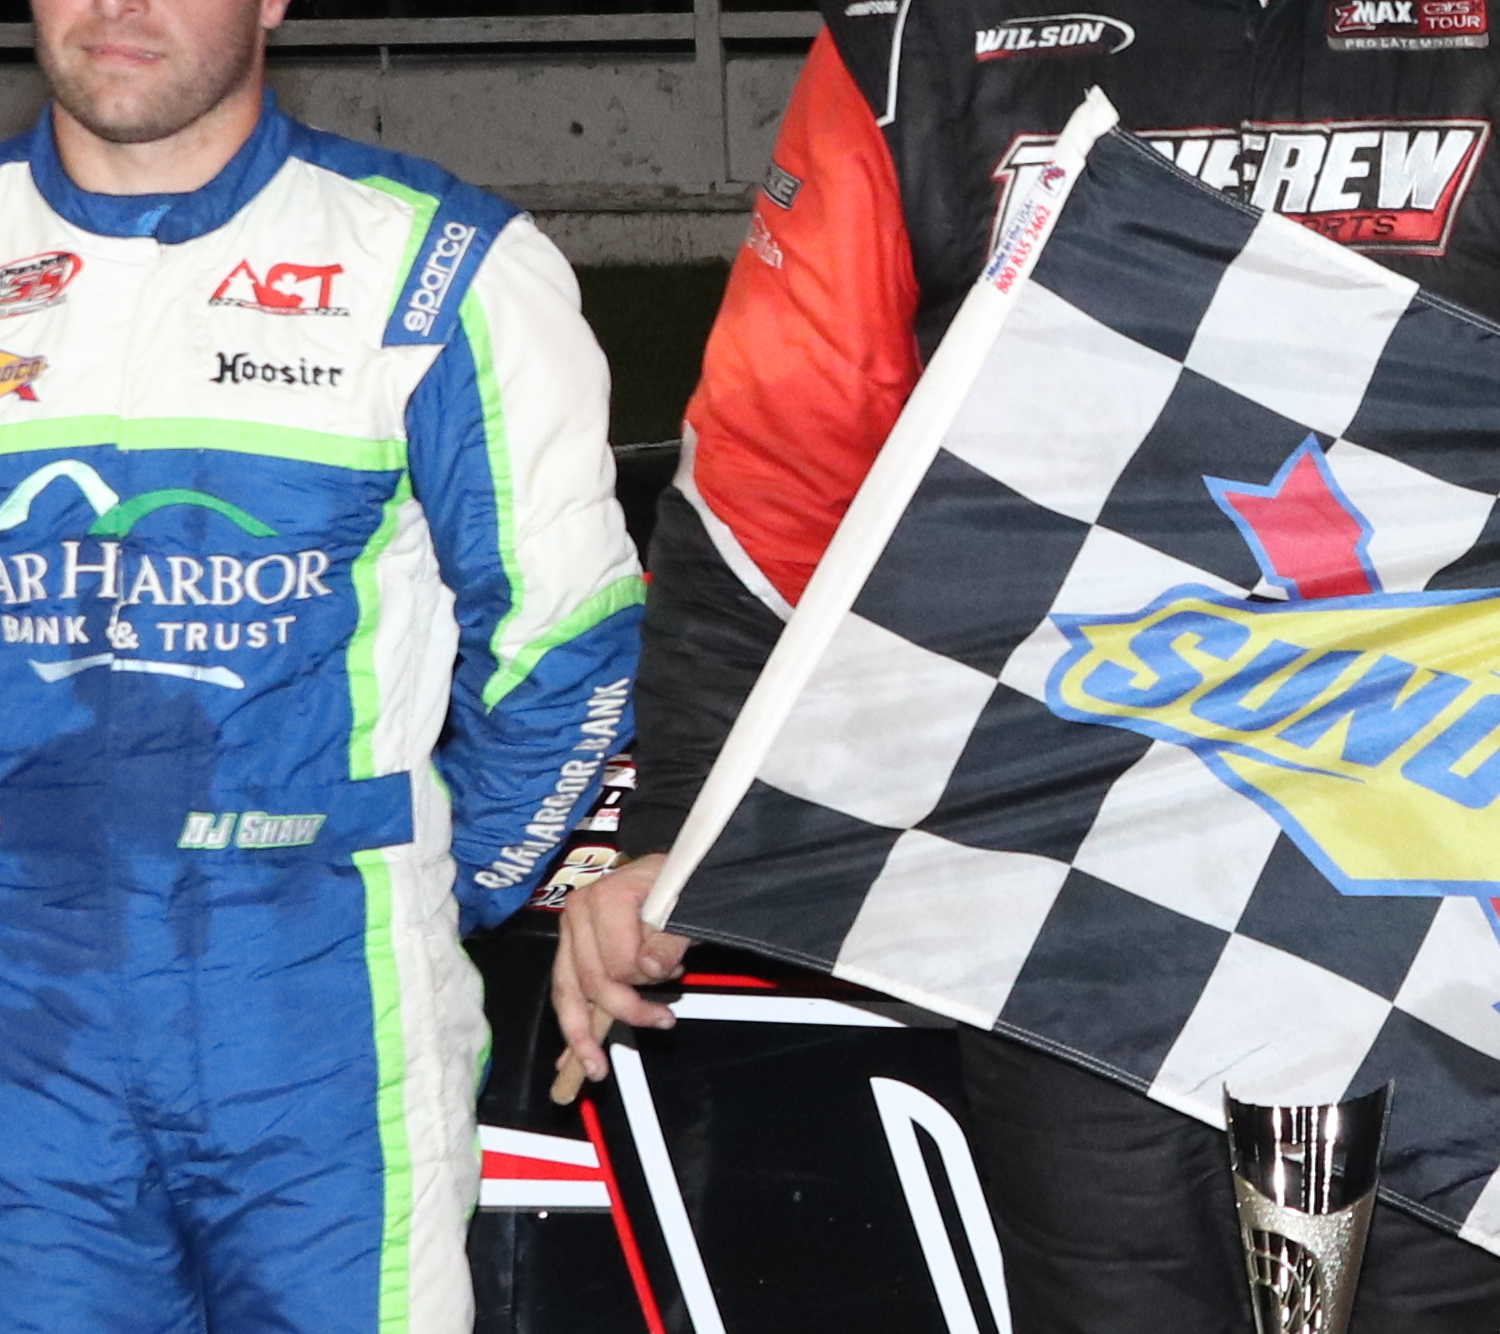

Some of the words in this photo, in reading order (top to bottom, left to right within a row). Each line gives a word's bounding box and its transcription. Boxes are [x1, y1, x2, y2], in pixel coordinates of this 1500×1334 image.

[974, 21, 1105, 55] WILSON
[1427, 15, 1482, 31] TOUR
[995, 265, 1019, 295] 800
[1010, 240, 1033, 268] 835
[1025, 204, 1053, 242] 2462
[210, 259, 345, 309] ACT
[402, 220, 477, 336] sparco
[208, 351, 344, 387] Hoosier
[60, 541, 332, 607] HARBOR
[2, 615, 91, 646] BANK
[105, 620, 141, 651] &
[155, 616, 297, 653] TRUST
[472, 677, 633, 892] BARHARBOR.BANK
